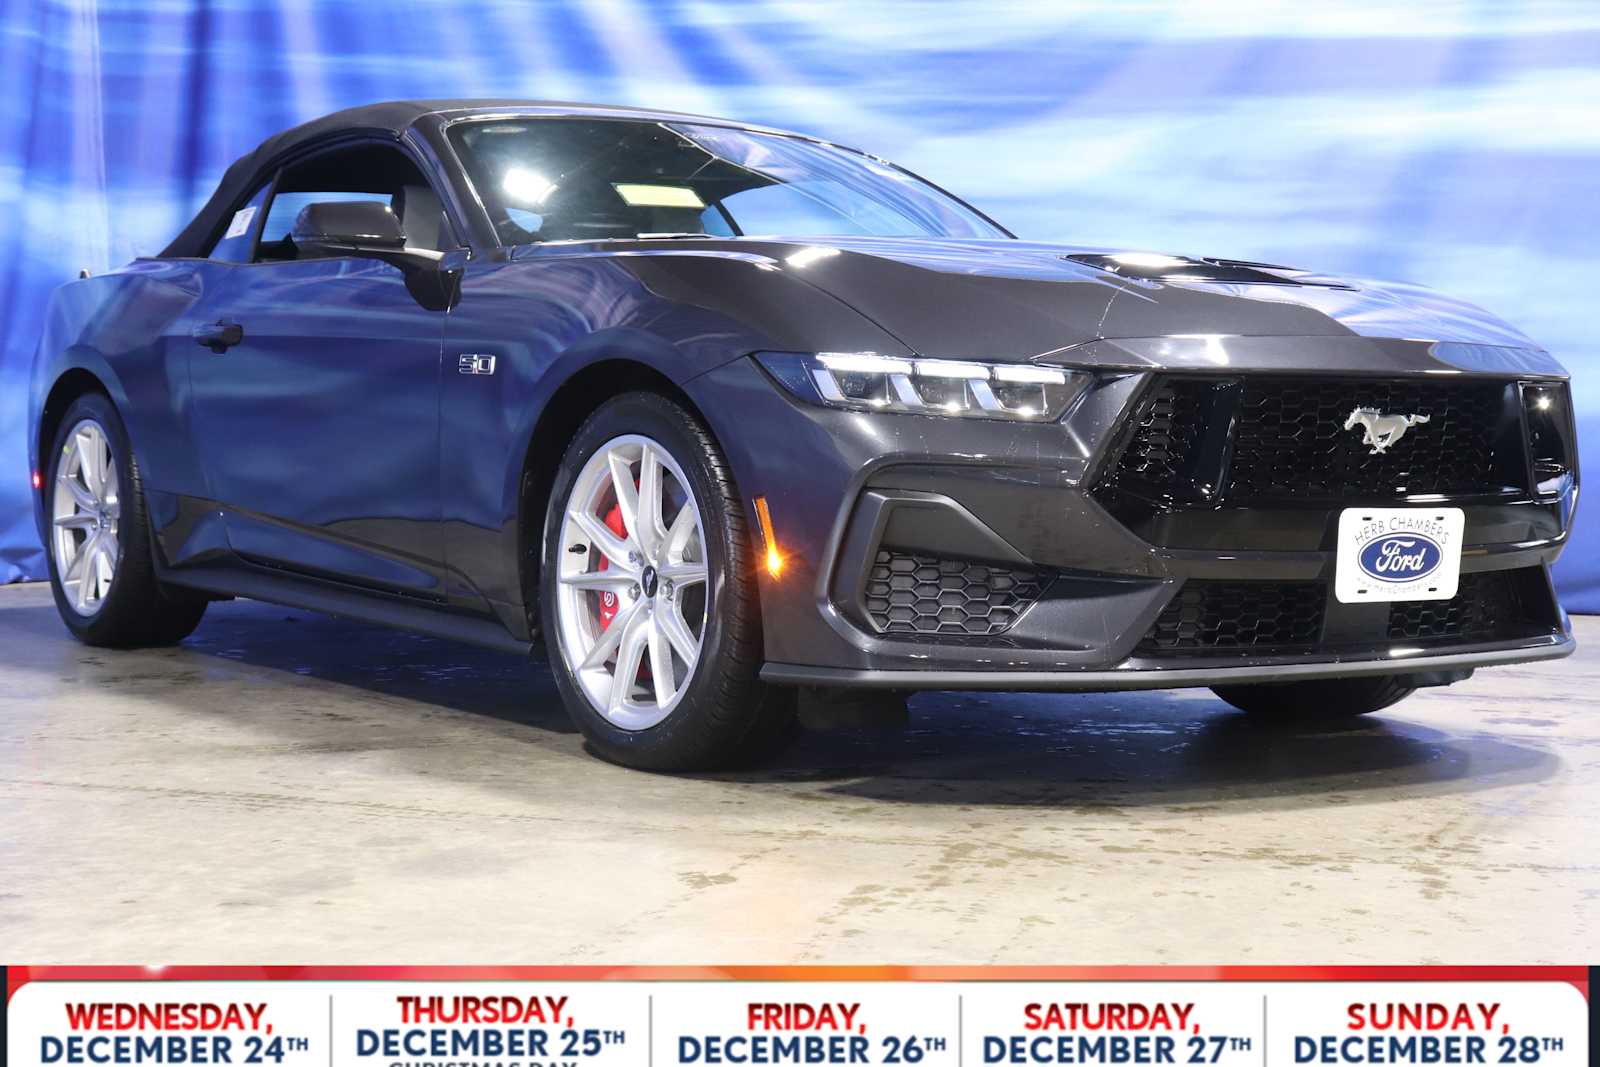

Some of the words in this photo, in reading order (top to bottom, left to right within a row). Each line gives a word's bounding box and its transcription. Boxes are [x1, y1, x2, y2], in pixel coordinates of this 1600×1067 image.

[1354, 520, 1385, 545] HERB
[1389, 517, 1450, 545] CHAMBERS
[1375, 539, 1427, 573] Ford
